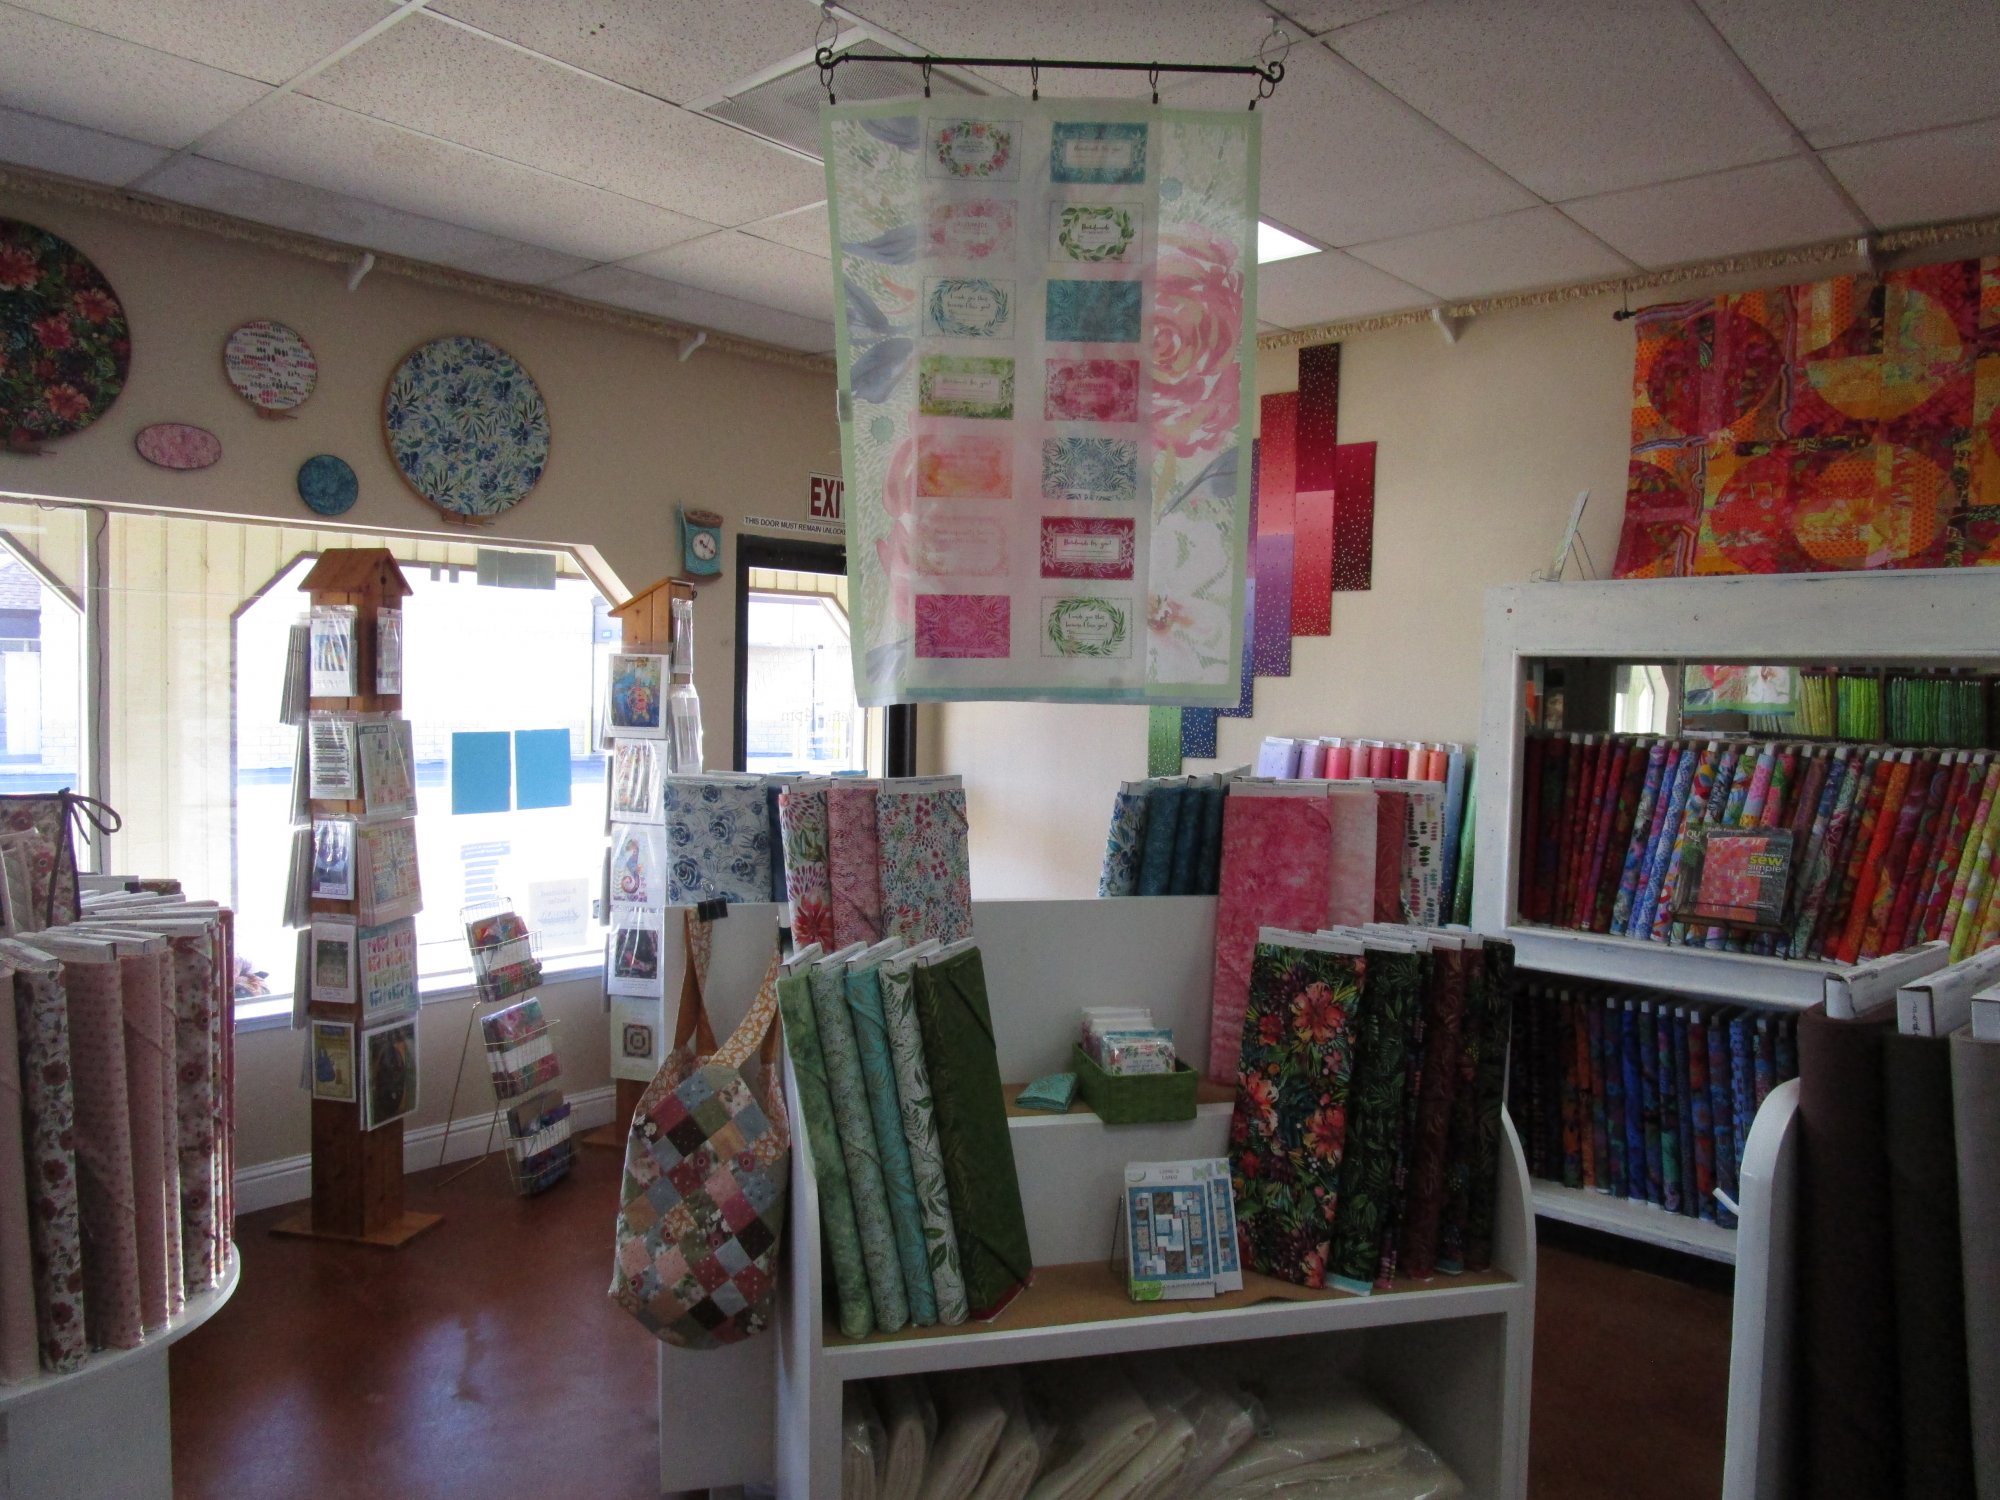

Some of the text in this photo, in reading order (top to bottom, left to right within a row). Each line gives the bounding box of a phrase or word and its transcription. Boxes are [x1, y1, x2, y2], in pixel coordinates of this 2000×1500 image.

[744, 516, 760, 526] THIS
[760, 518, 780, 528] DOOR
[780, 521, 797, 530] MUST
[798, 523, 822, 533] REMAIN
[1750, 855, 1784, 866] sew
[1747, 863, 1782, 873] simple
